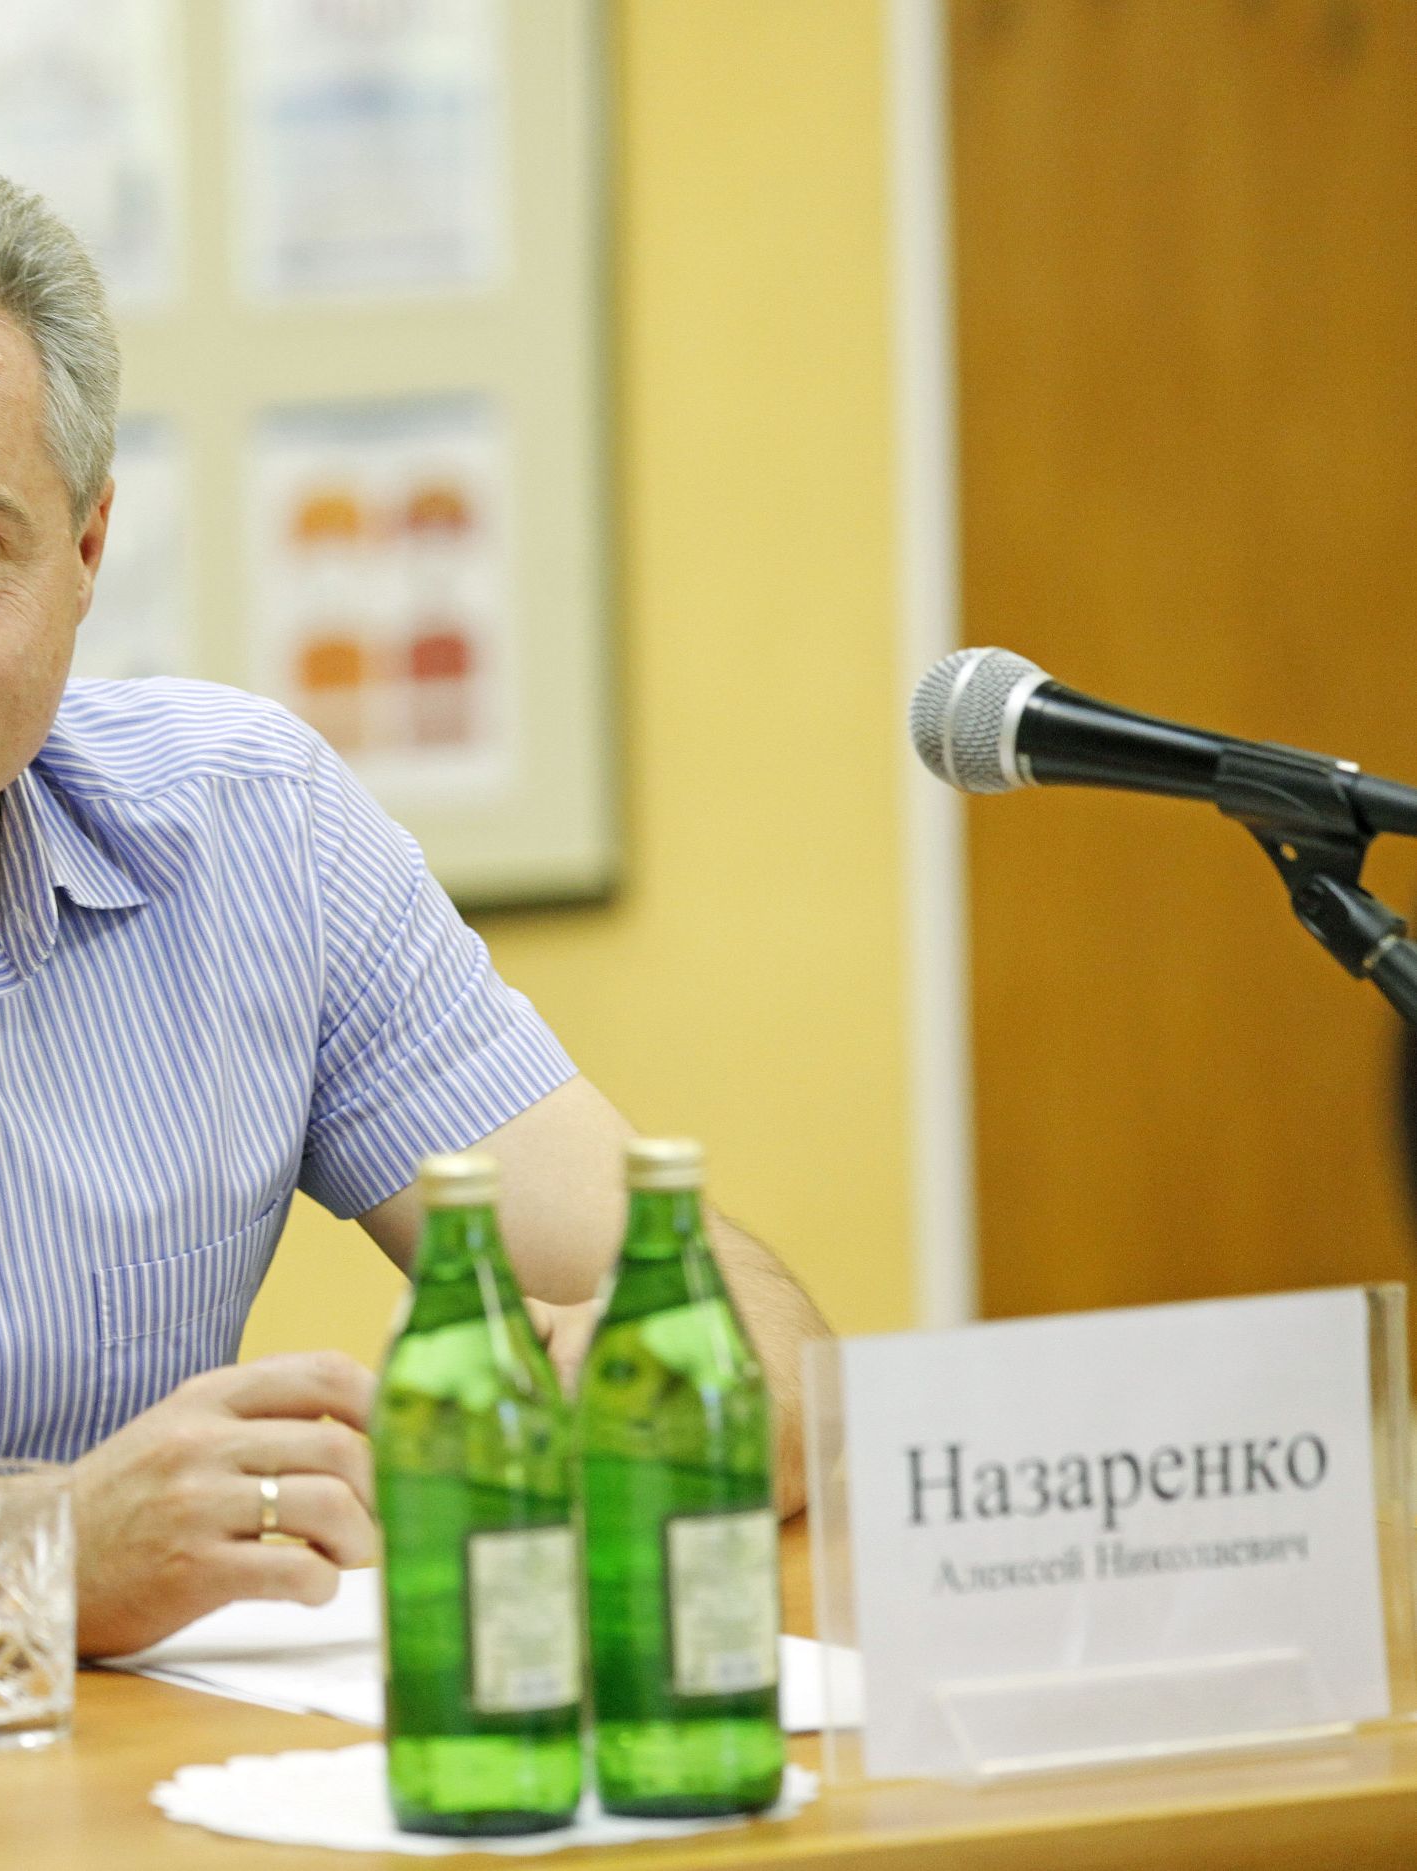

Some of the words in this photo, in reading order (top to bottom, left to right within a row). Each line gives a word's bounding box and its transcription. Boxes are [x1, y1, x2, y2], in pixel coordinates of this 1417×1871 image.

[904, 1431, 1329, 1530] Назаренко
[933, 1546, 1084, 1596] Алексей
[1095, 1532, 1309, 1582] Николаевич
